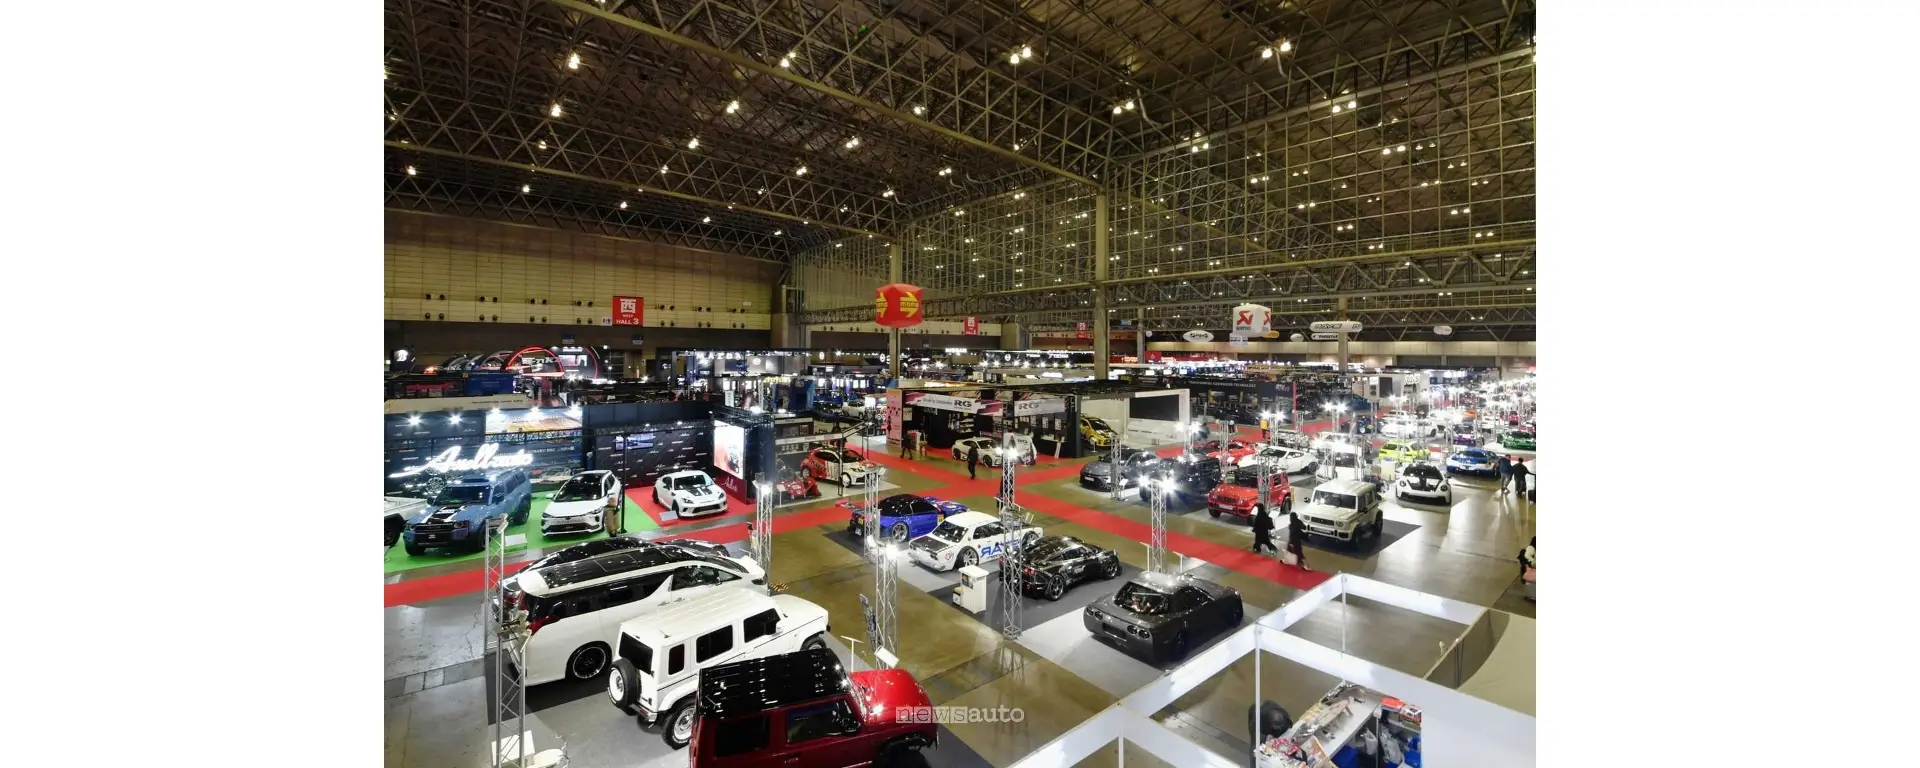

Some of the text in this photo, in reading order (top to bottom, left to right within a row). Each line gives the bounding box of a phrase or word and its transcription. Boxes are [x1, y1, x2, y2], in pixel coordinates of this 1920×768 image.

[620, 298, 637, 313] 西
[696, 352, 742, 360] MAZDA
[954, 399, 972, 408] RG
[1018, 402, 1040, 410] RG
